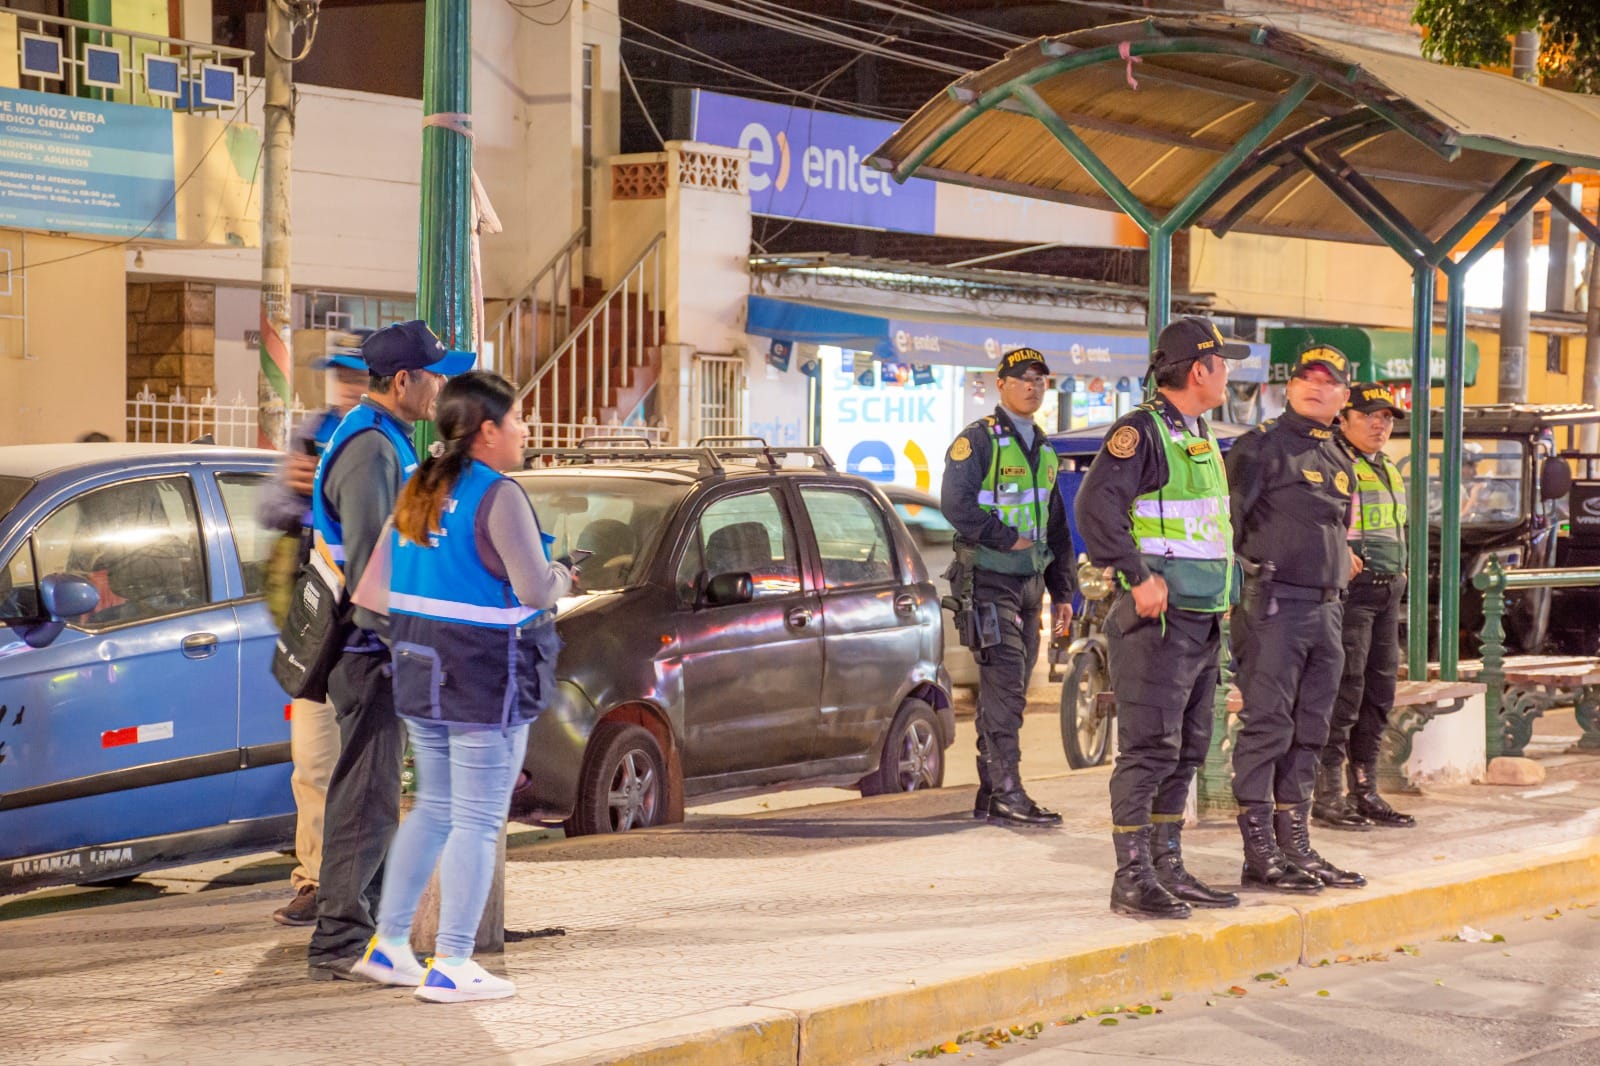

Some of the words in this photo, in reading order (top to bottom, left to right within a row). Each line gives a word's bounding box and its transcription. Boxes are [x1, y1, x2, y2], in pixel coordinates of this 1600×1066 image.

[15, 102, 68, 120] MUÑOZ
[70, 110, 106, 124] VERA
[38, 118, 94, 134] CIRUJANO
[802, 145, 892, 197] entel
[838, 396, 936, 424] SCHIK
